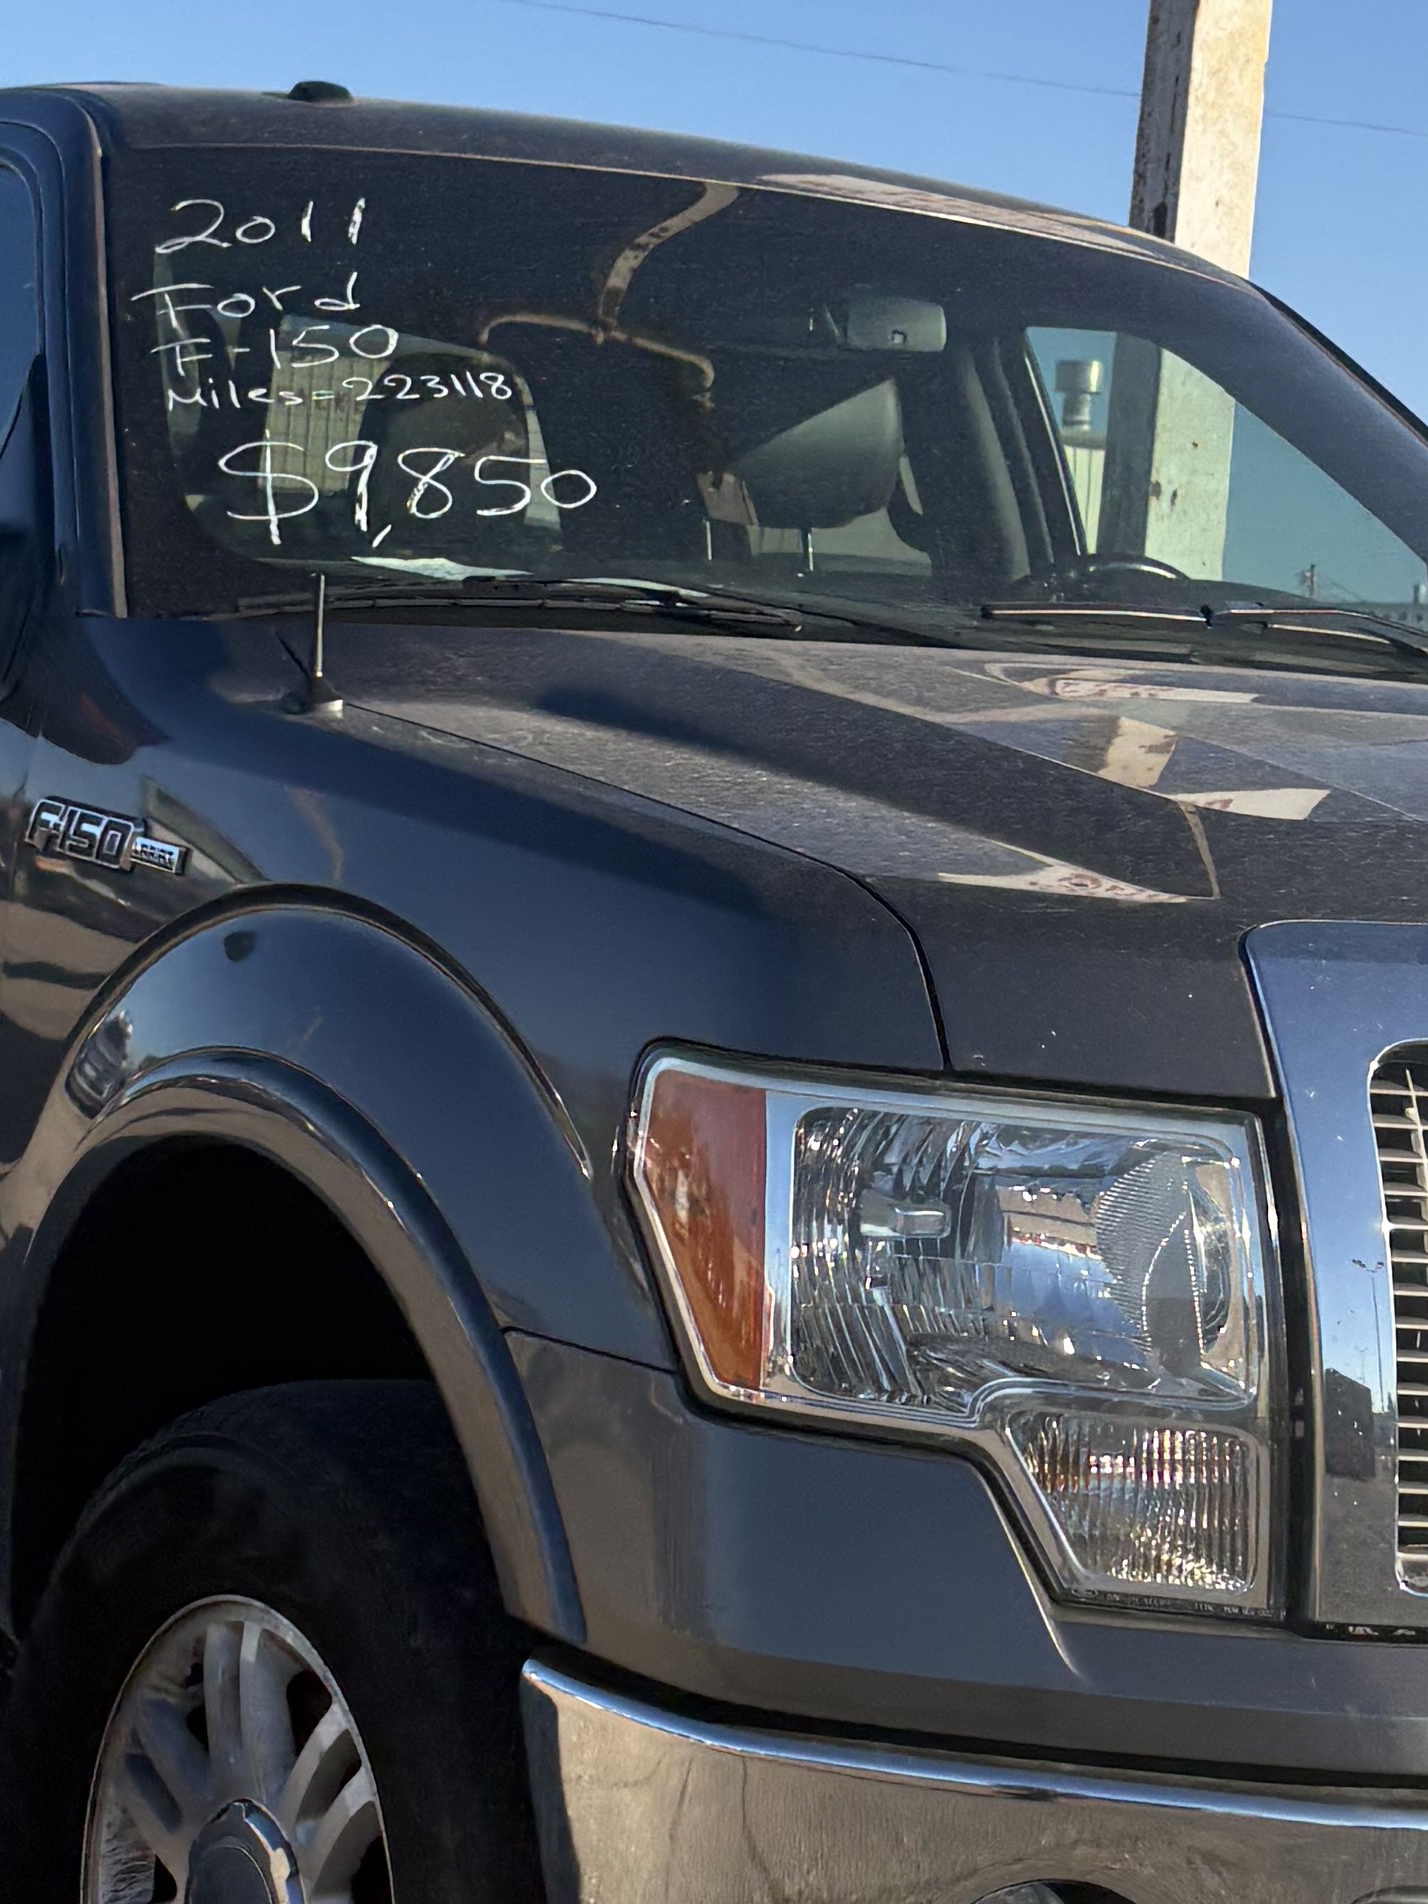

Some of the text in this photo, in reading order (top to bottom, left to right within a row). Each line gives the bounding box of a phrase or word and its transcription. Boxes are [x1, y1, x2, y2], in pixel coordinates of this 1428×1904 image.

[155, 198, 366, 254] 2011
[130, 271, 361, 339] Ford
[150, 324, 399, 376] F-150
[218, 429, 598, 548] $9,850
